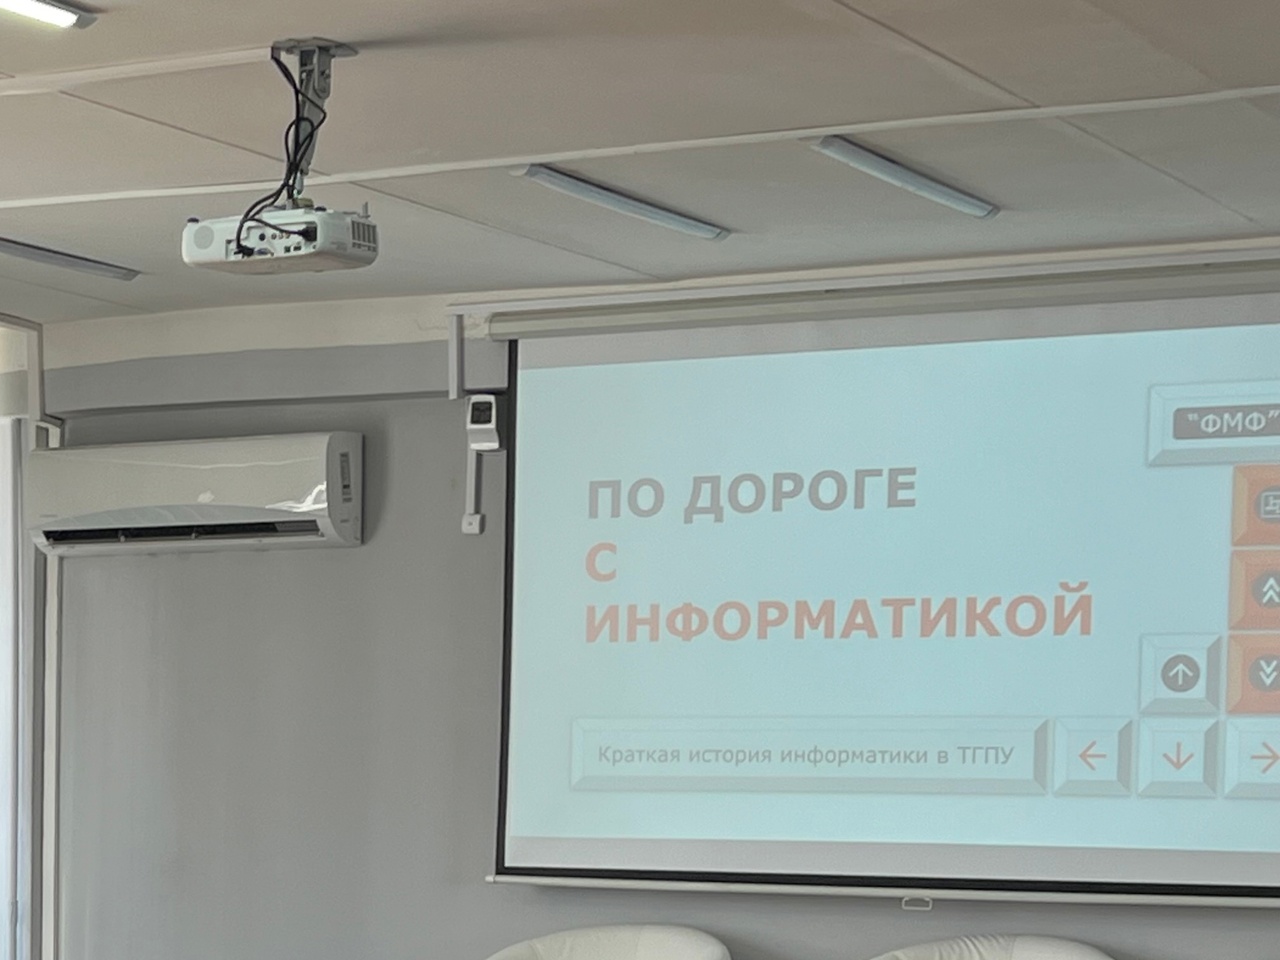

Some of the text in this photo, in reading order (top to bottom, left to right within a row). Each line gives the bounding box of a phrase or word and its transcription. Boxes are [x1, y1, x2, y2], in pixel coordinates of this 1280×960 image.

[587, 467, 918, 523] ПО ДОРОГЕ
[584, 541, 618, 582] С
[585, 582, 1093, 643] ИНФОРМАТИКОЙ
[597, 745, 1015, 768] Краткая история информатики в ТГПУ
